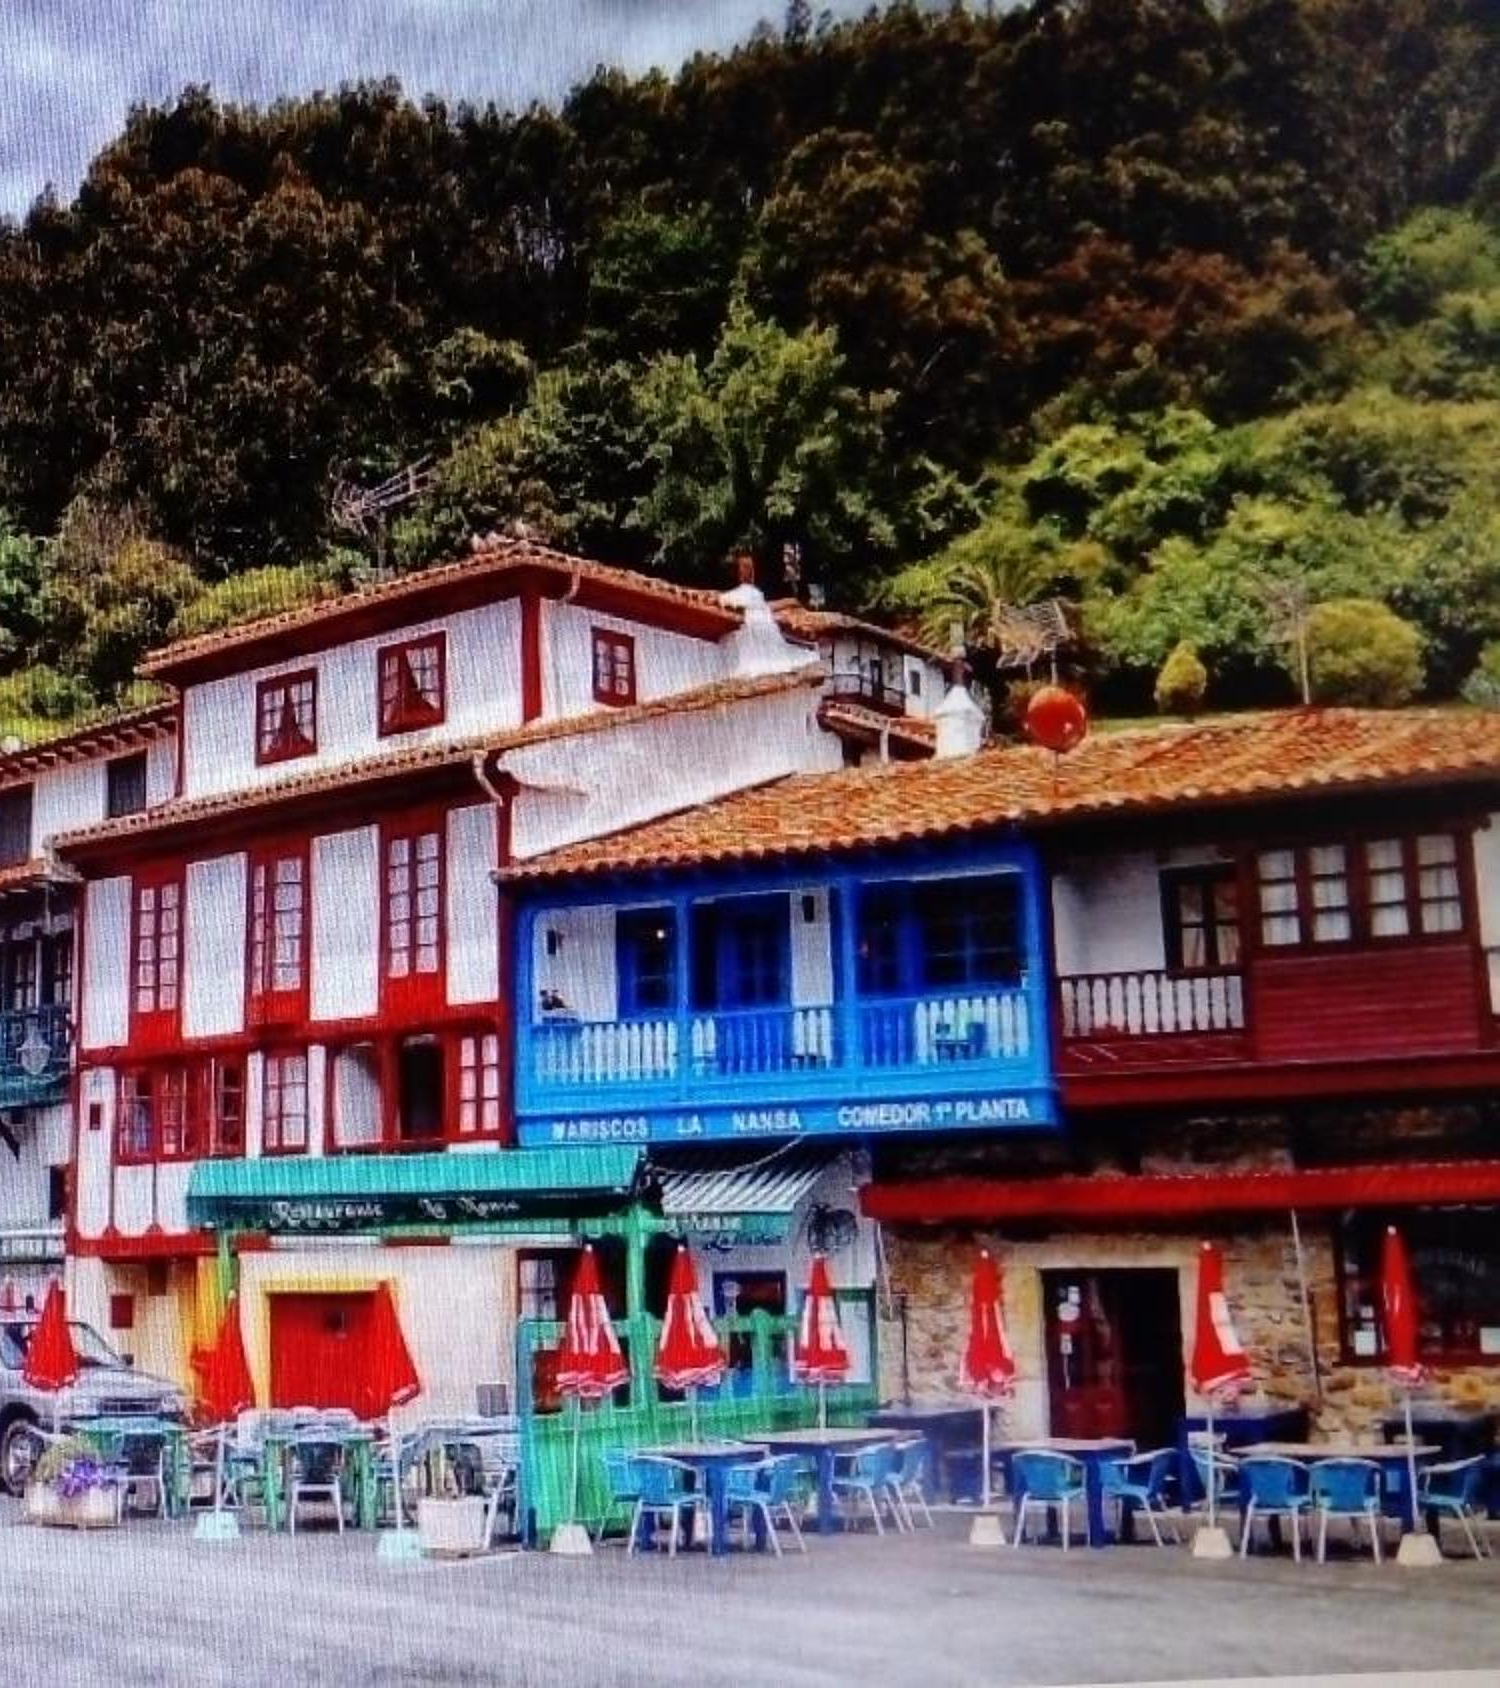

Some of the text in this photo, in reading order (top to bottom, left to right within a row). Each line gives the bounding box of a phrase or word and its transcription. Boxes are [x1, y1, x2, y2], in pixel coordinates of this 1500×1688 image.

[552, 1116, 649, 1141] MARISCOS
[677, 1114, 702, 1134] LA
[732, 1110, 802, 1133] NANSA
[837, 1102, 931, 1128] COMEDOR
[955, 1097, 1030, 1121] PLANTA
